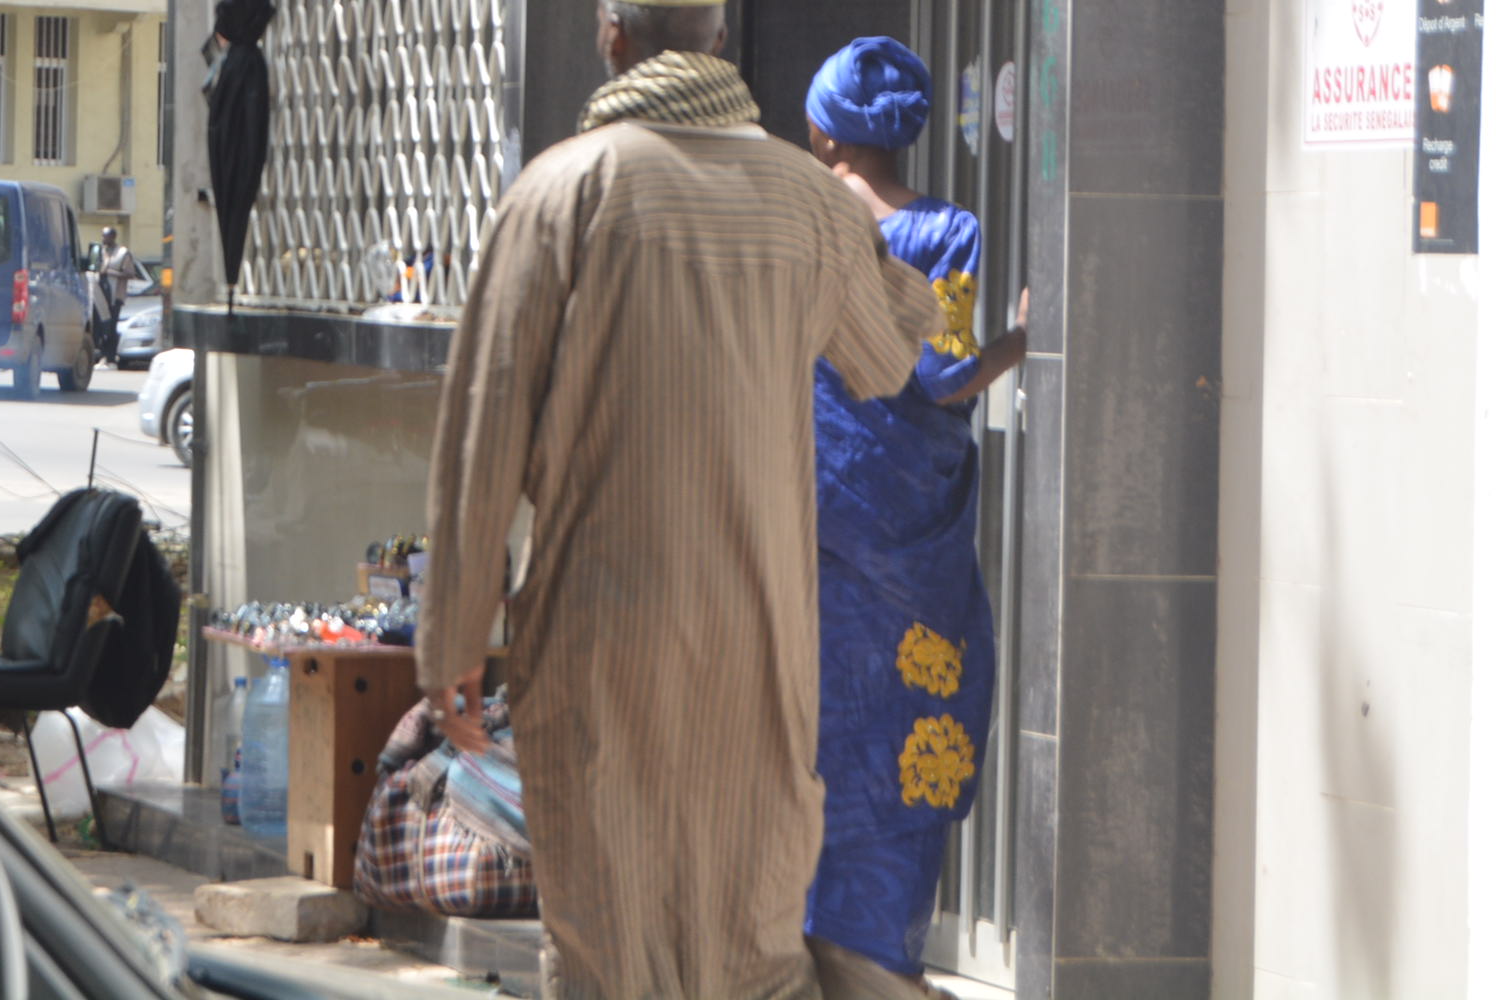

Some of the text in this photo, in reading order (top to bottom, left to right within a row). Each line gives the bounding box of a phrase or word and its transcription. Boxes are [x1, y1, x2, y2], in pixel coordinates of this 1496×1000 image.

[1312, 63, 1412, 104] ASSURANCE
[1311, 108, 1416, 132] LA SECURITE SENEGALAI
